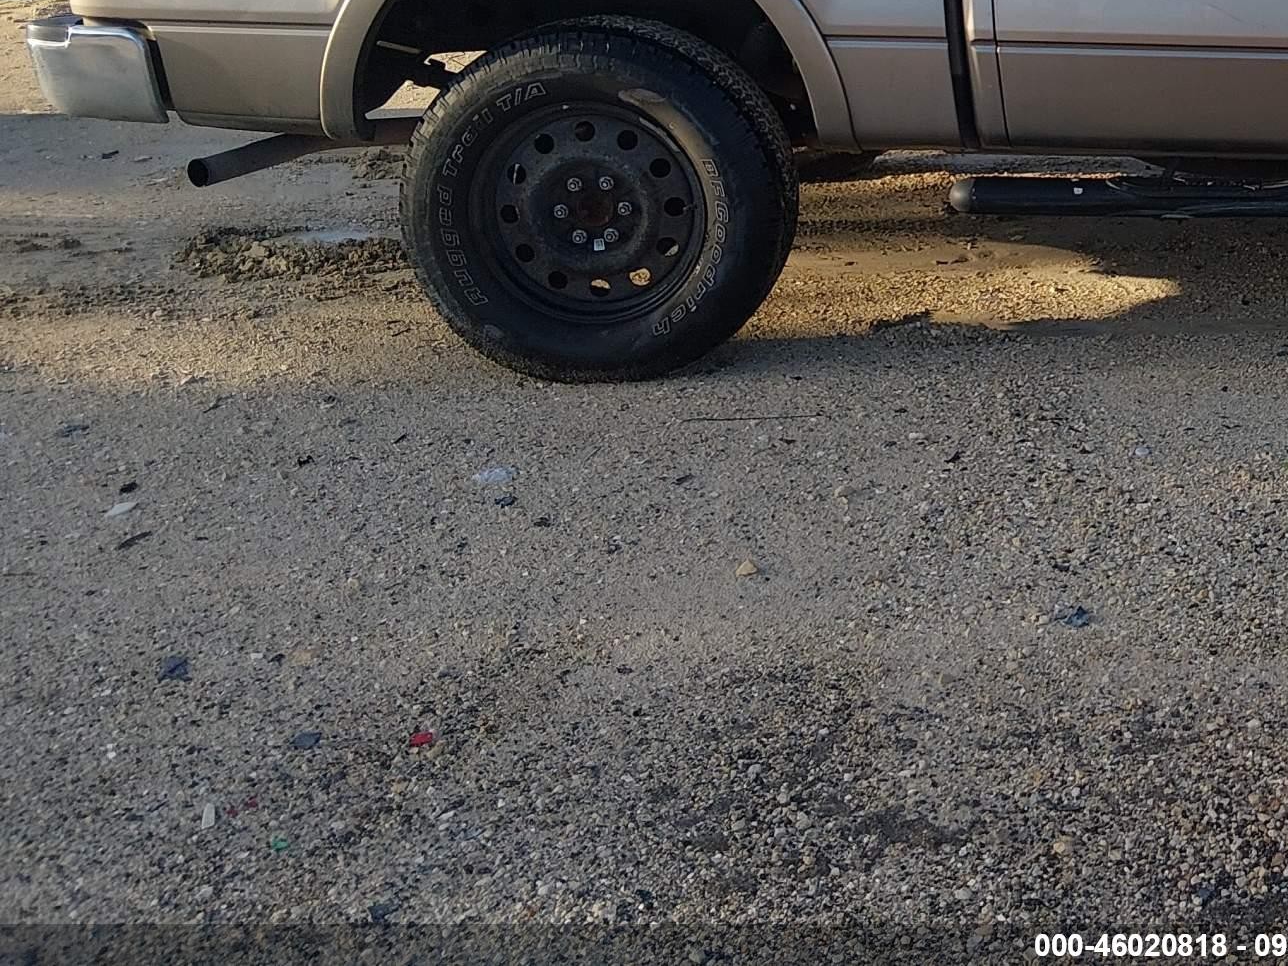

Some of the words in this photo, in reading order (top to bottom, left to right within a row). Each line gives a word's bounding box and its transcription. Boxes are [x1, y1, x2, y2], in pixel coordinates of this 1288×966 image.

[437, 185, 488, 306] Rugged
[496, 82, 547, 112] T/A
[652, 158, 729, 335] BFGoodrich
